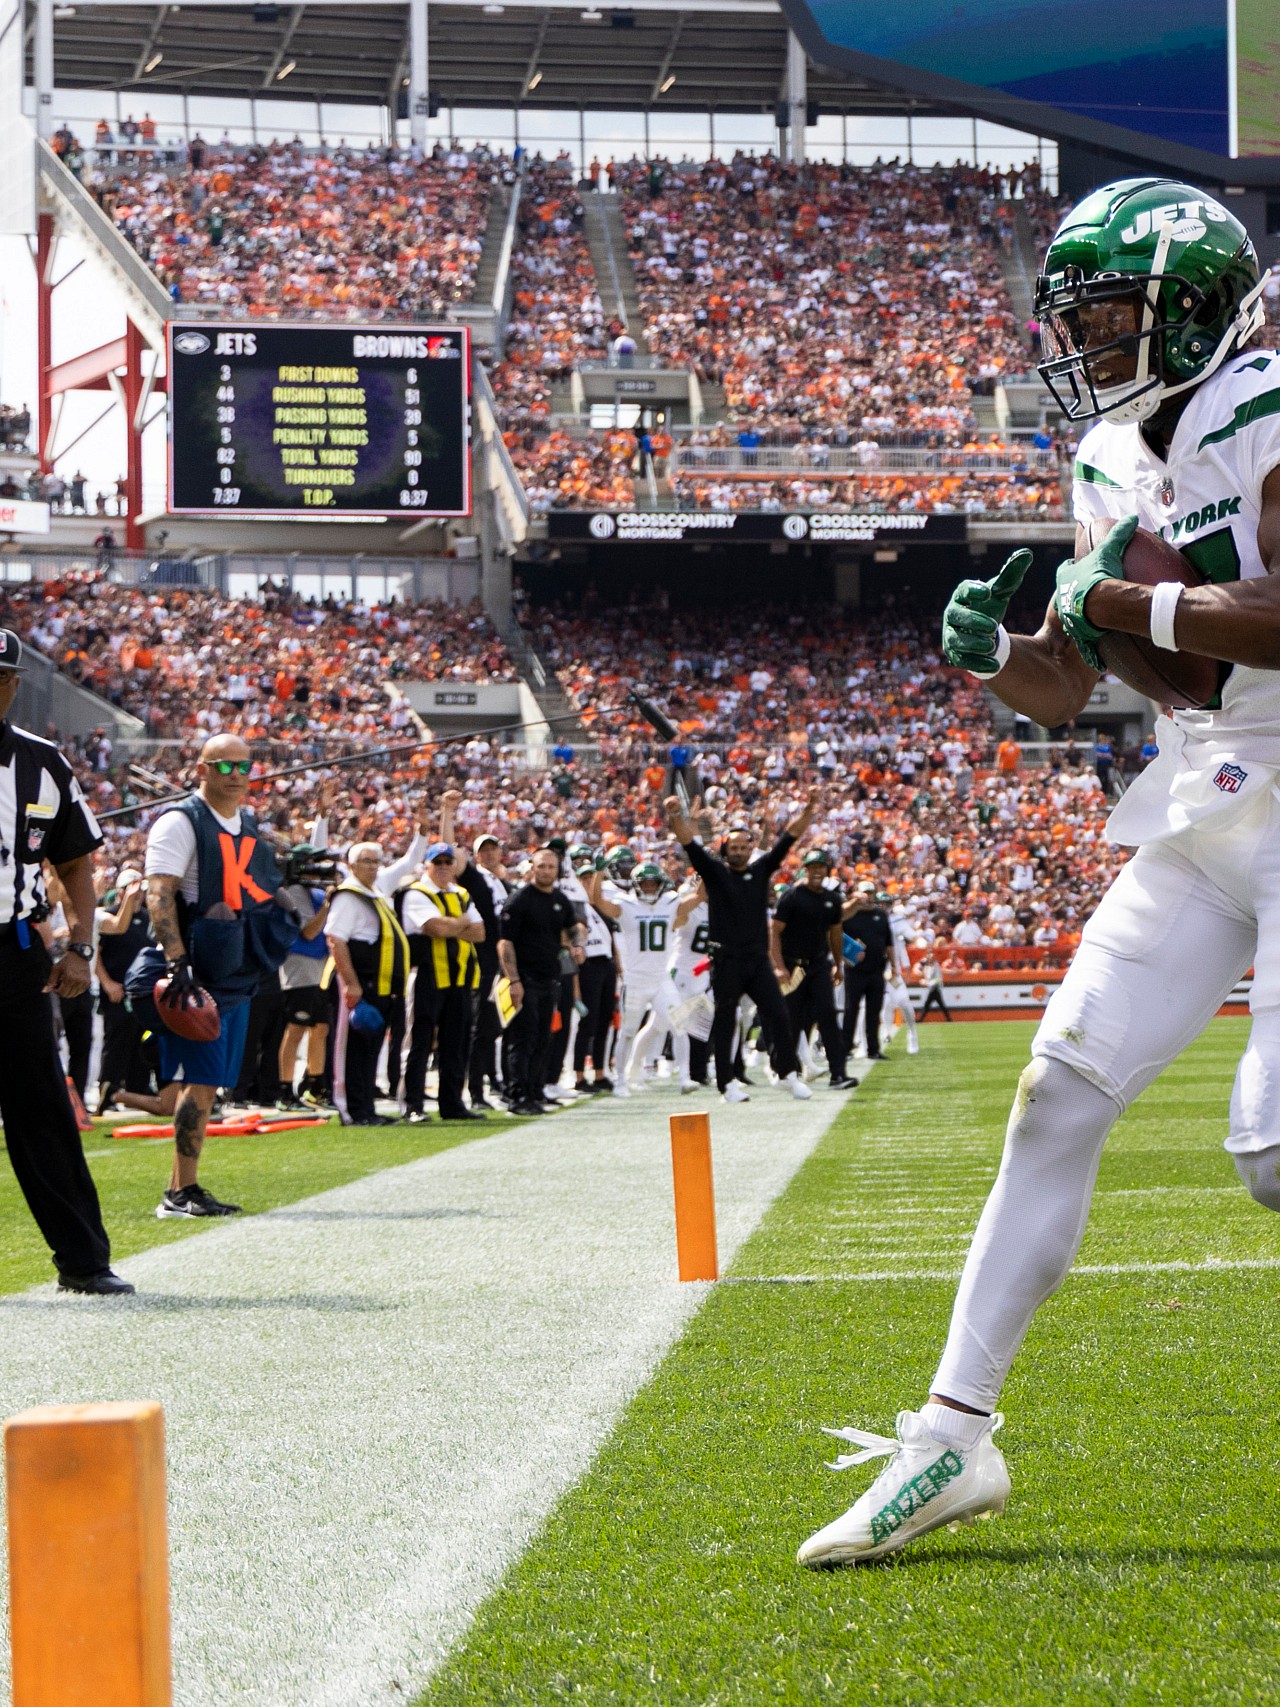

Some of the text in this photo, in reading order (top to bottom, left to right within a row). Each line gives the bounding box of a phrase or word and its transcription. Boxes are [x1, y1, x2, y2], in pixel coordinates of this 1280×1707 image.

[1121, 200, 1227, 245] JETS
[214, 333, 258, 355] JETS
[353, 335, 428, 359] BROWNS
[278, 366, 313, 383] FIRST
[314, 367, 359, 384] DOWNS
[272, 387, 326, 404] RUSHING
[326, 388, 366, 405] YARDS
[275, 408, 327, 424] PASSING
[327, 409, 367, 425] YARDS
[273, 429, 327, 445] PENALTY
[328, 430, 369, 446] YARDS
[281, 449, 317, 465] TOTAL
[319, 450, 359, 467] YARDS
[284, 469, 356, 486] TURNOVERS
[617, 514, 737, 529] CROSSCOUNTRY
[809, 515, 928, 530] CROSSCOUNTRY
[1172, 495, 1242, 542] YORK
[618, 529, 683, 539] MORTGAGE
[811, 529, 875, 540] MORTGAGE
[1215, 771, 1239, 792] NFL
[218, 832, 274, 911] K
[639, 920, 667, 952] 10
